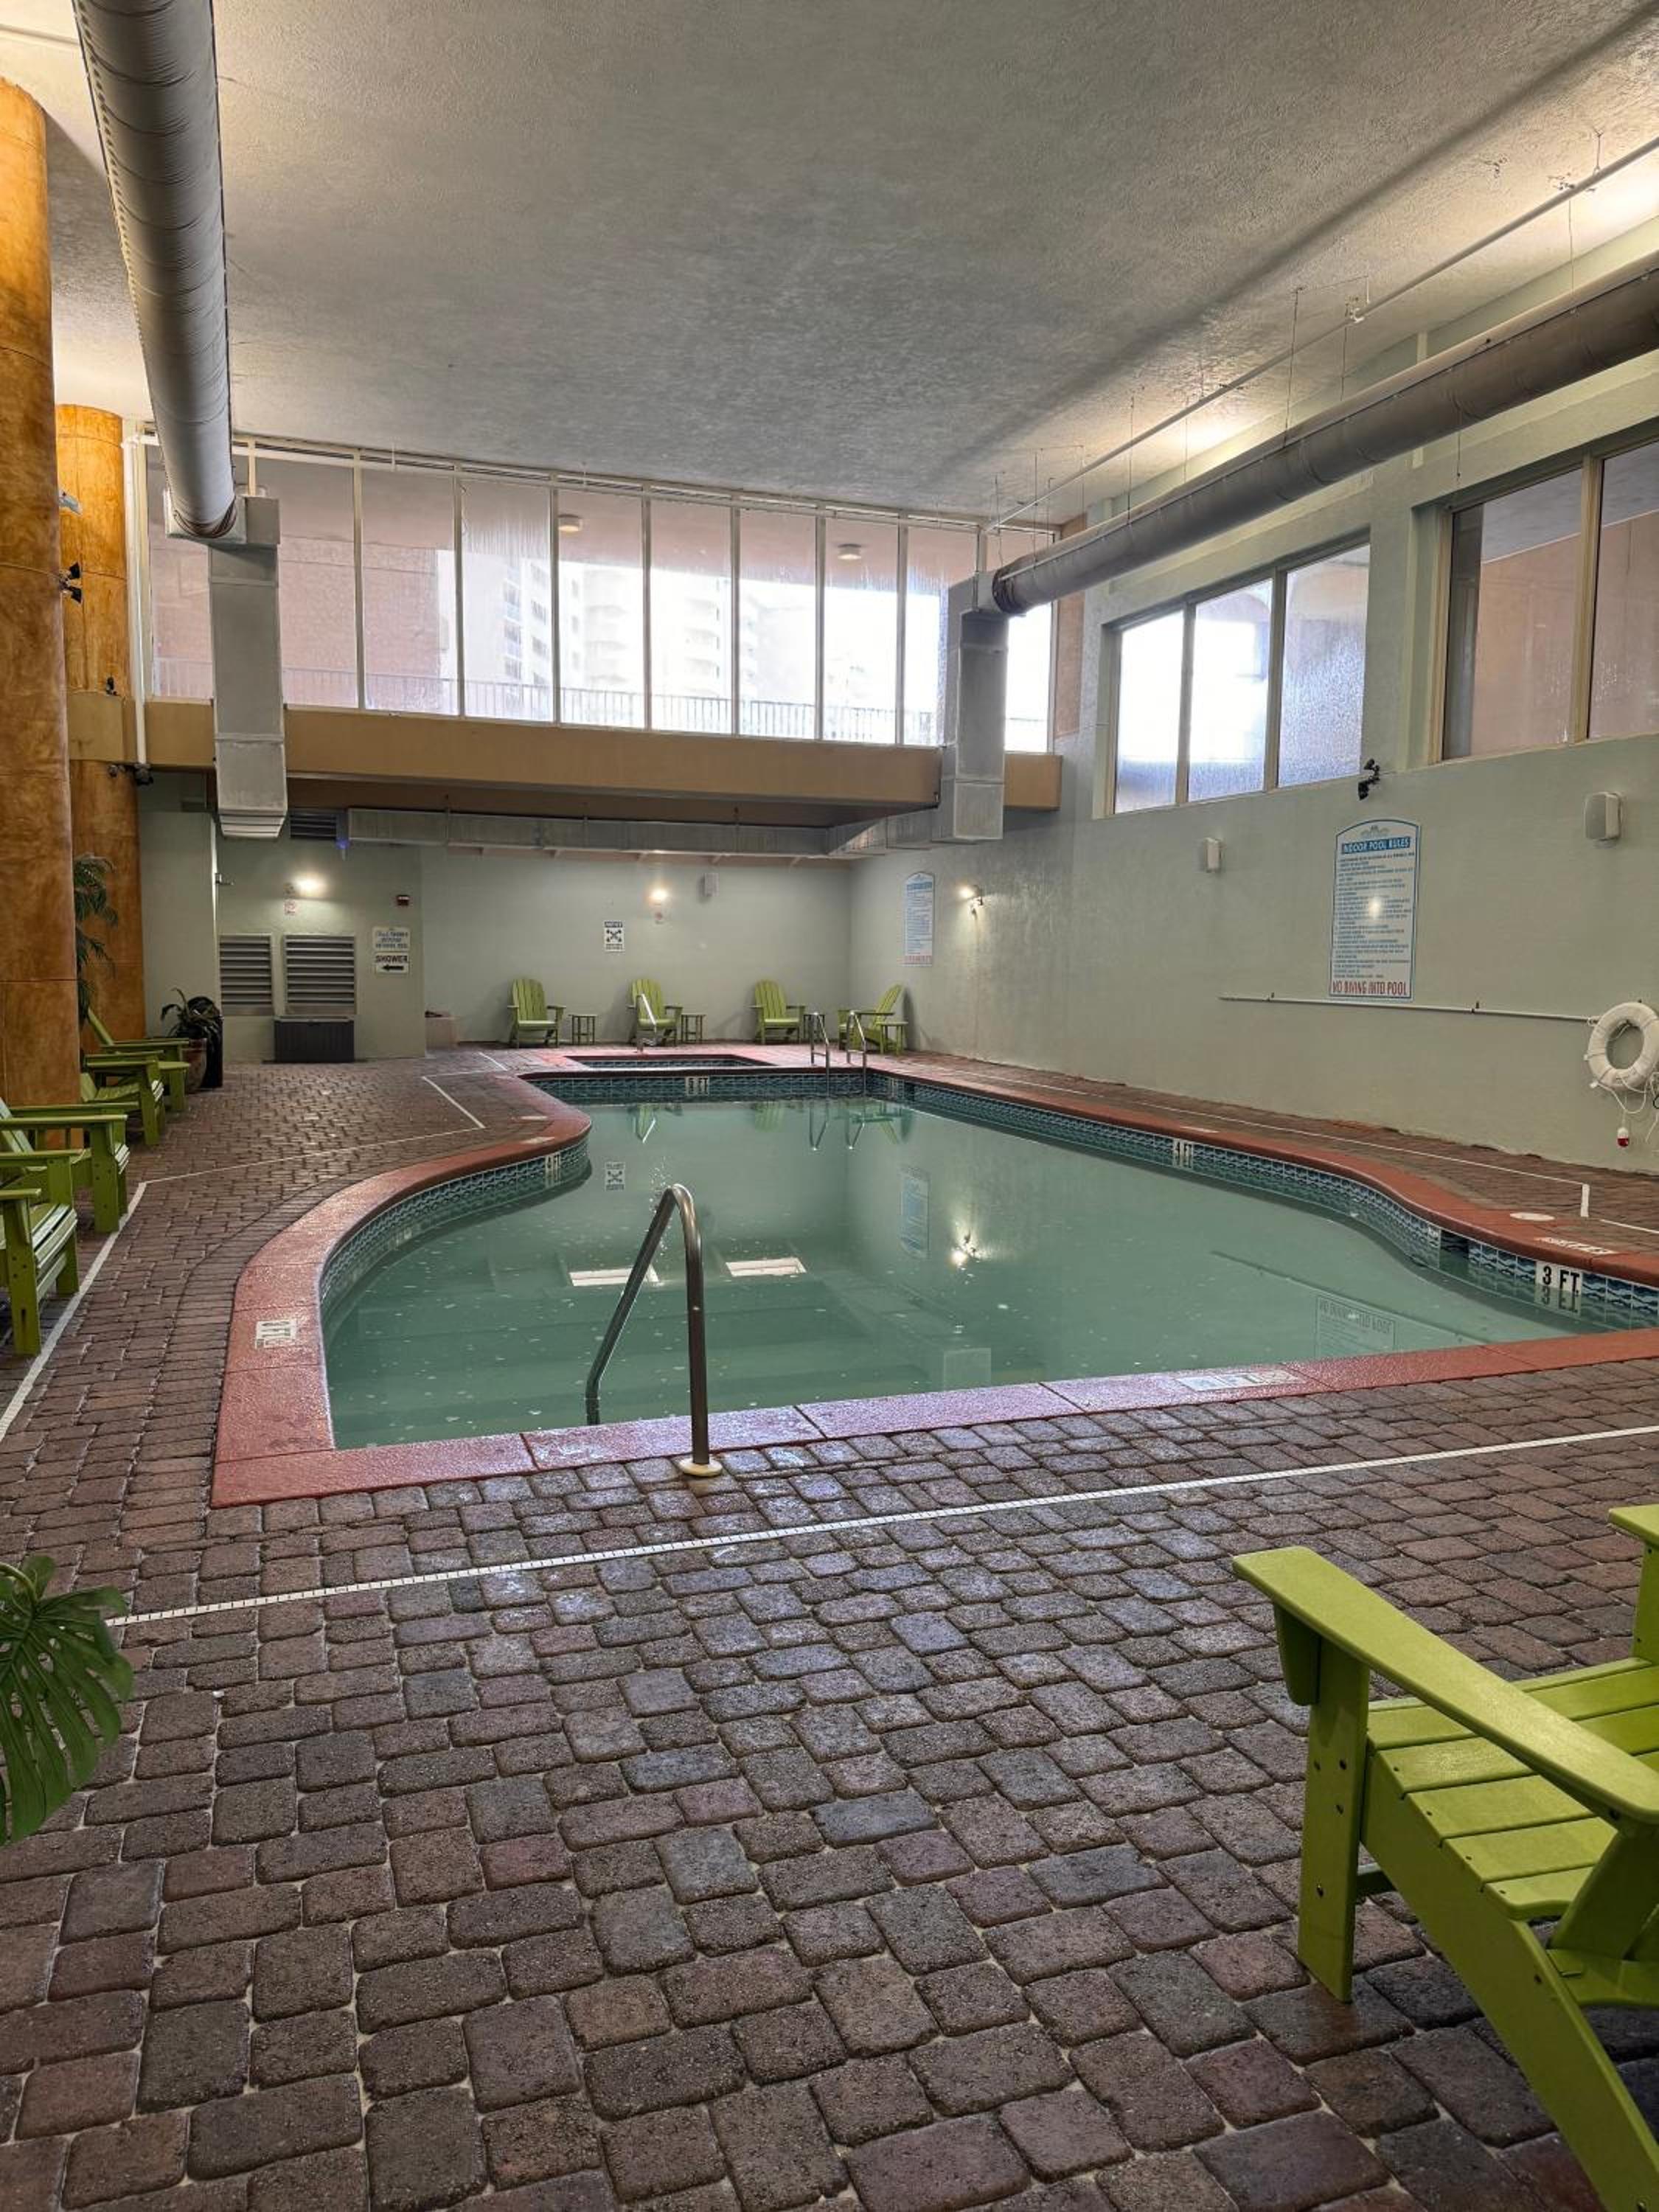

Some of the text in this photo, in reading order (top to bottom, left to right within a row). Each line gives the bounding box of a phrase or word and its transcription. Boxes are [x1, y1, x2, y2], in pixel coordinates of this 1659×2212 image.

[1369, 840, 1387, 850] POOL
[1332, 980, 1406, 996] NO DIVING INTO POOL
[1543, 1265, 1552, 1285] 3
